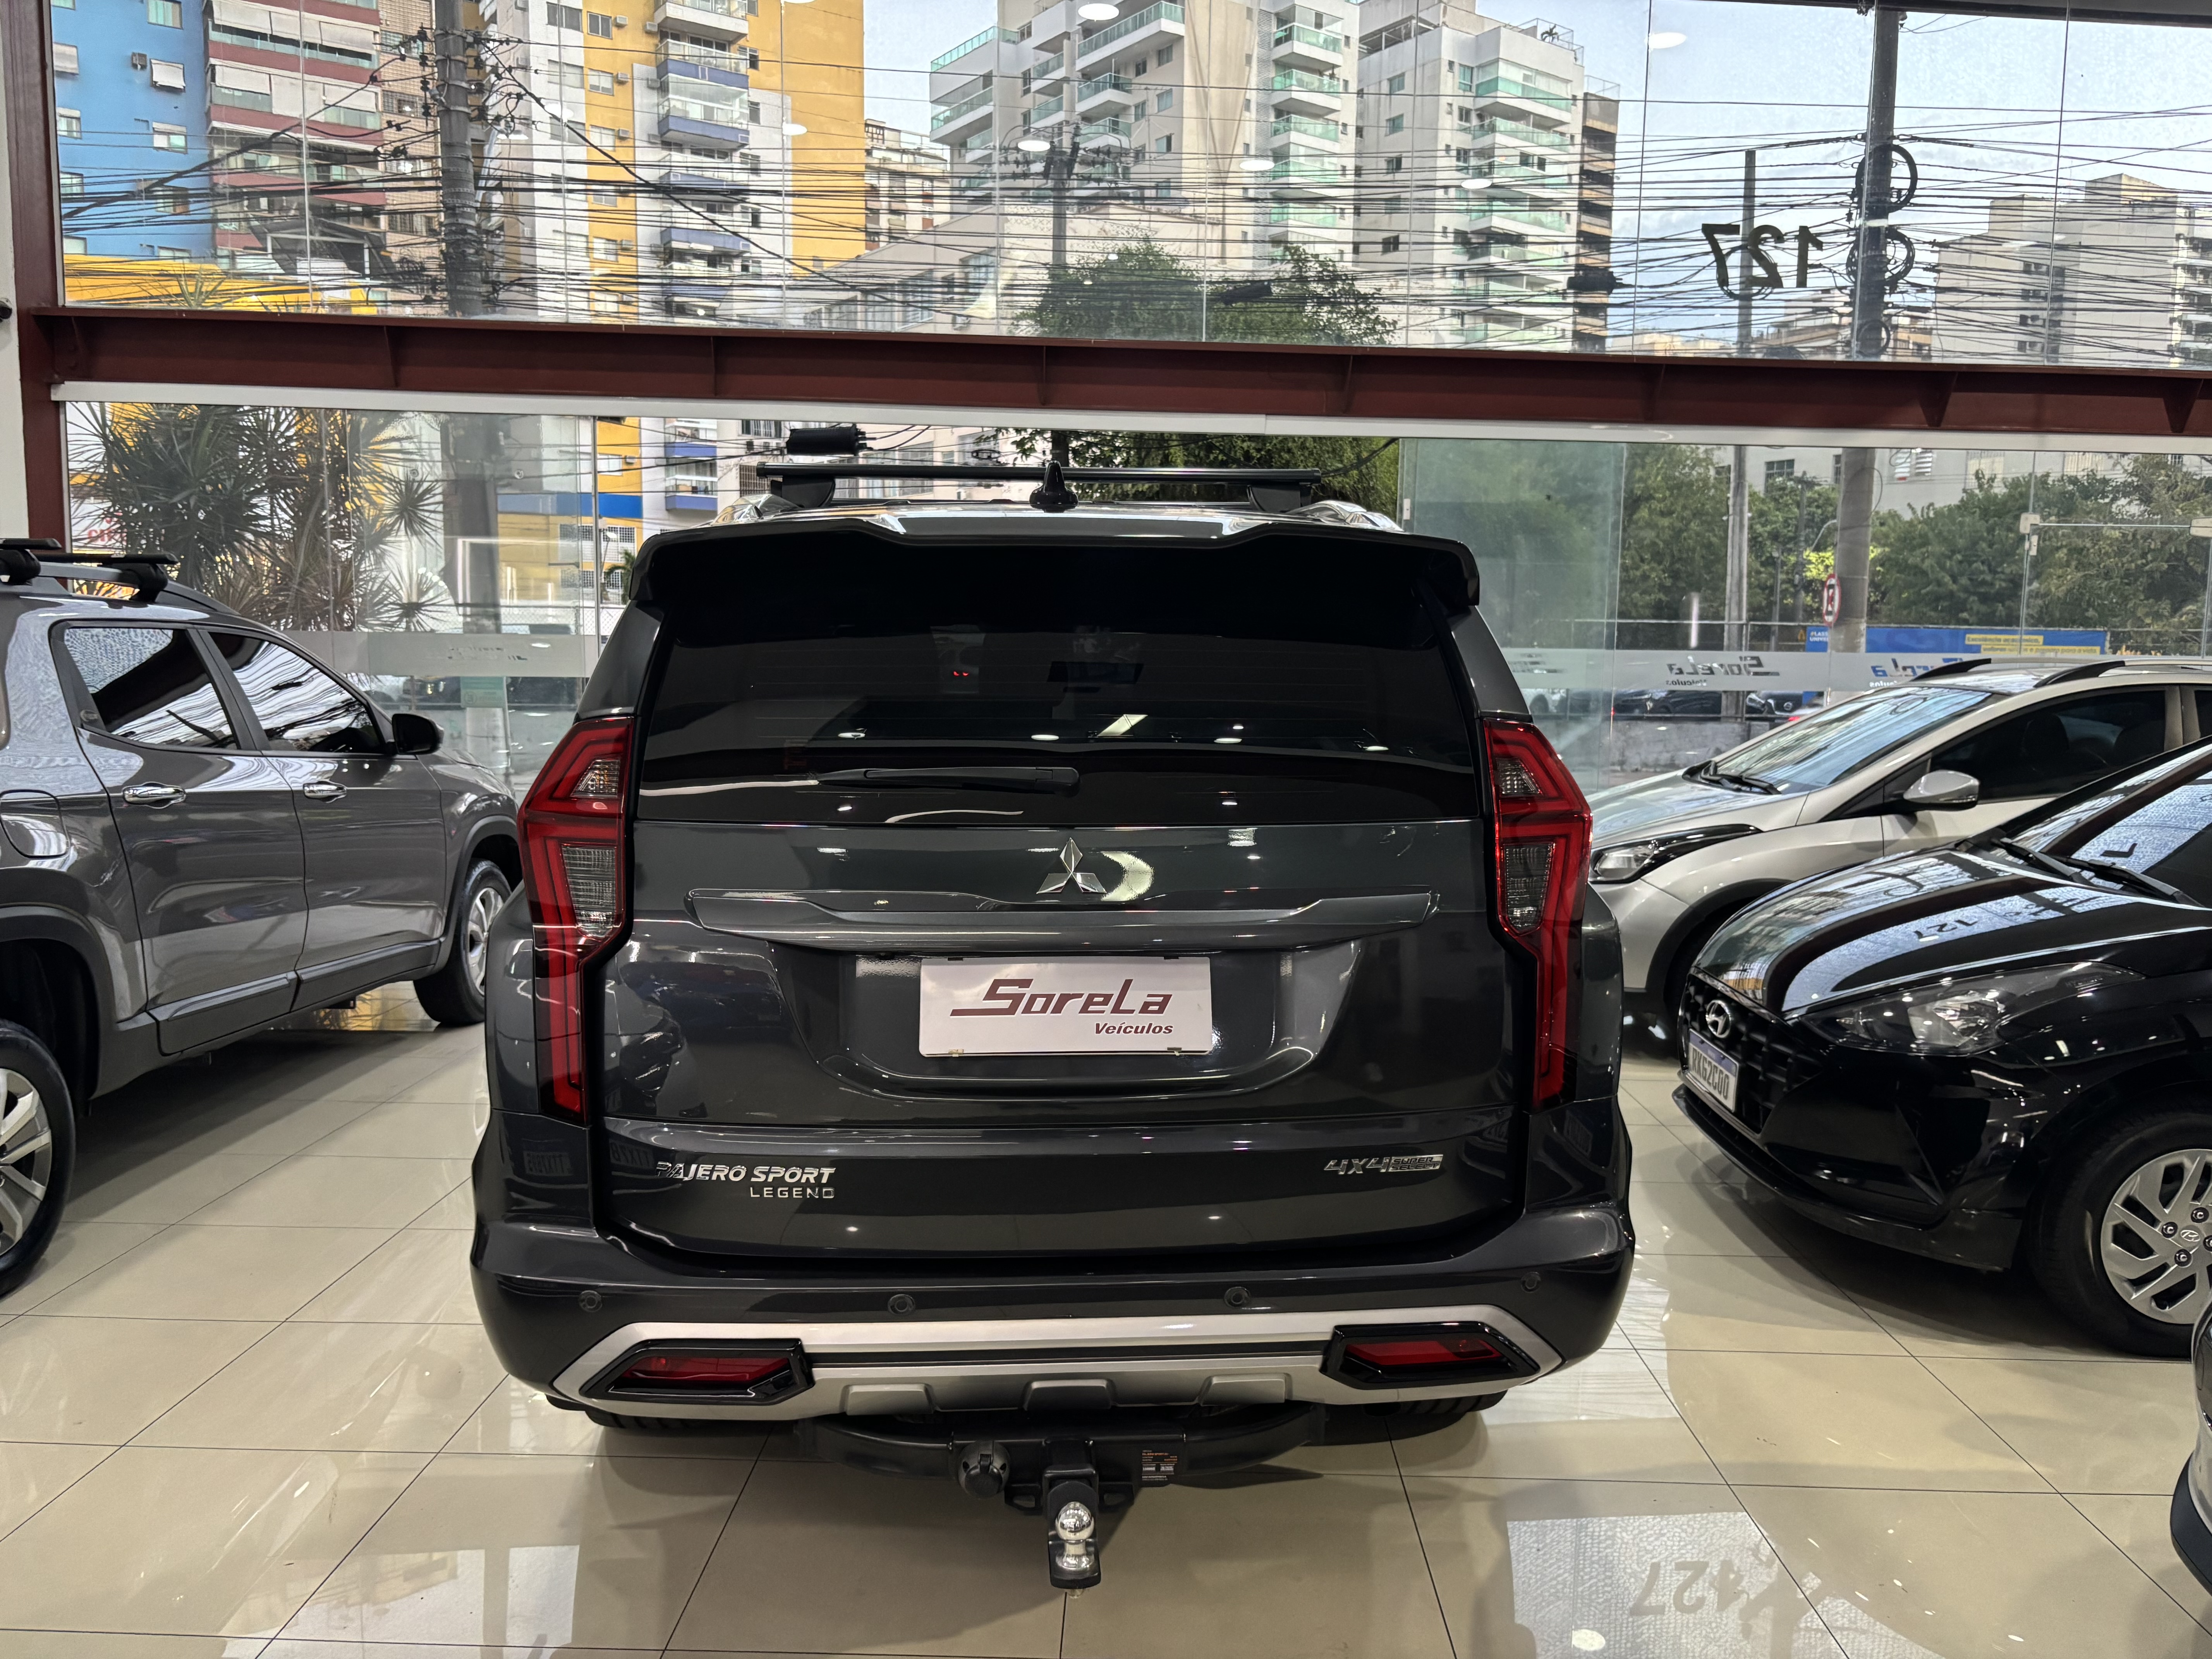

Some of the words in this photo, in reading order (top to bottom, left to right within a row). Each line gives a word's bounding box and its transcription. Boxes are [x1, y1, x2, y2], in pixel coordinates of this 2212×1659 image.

[1094, 1022, 1173, 1035] Veículos
[1391, 1163, 1439, 1171] SELECT
[1393, 1157, 1433, 1165] SUPER
[654, 1161, 747, 1182] PAJERO
[750, 1166, 836, 1183] SPORT
[750, 1187, 835, 1199] LEGEND
